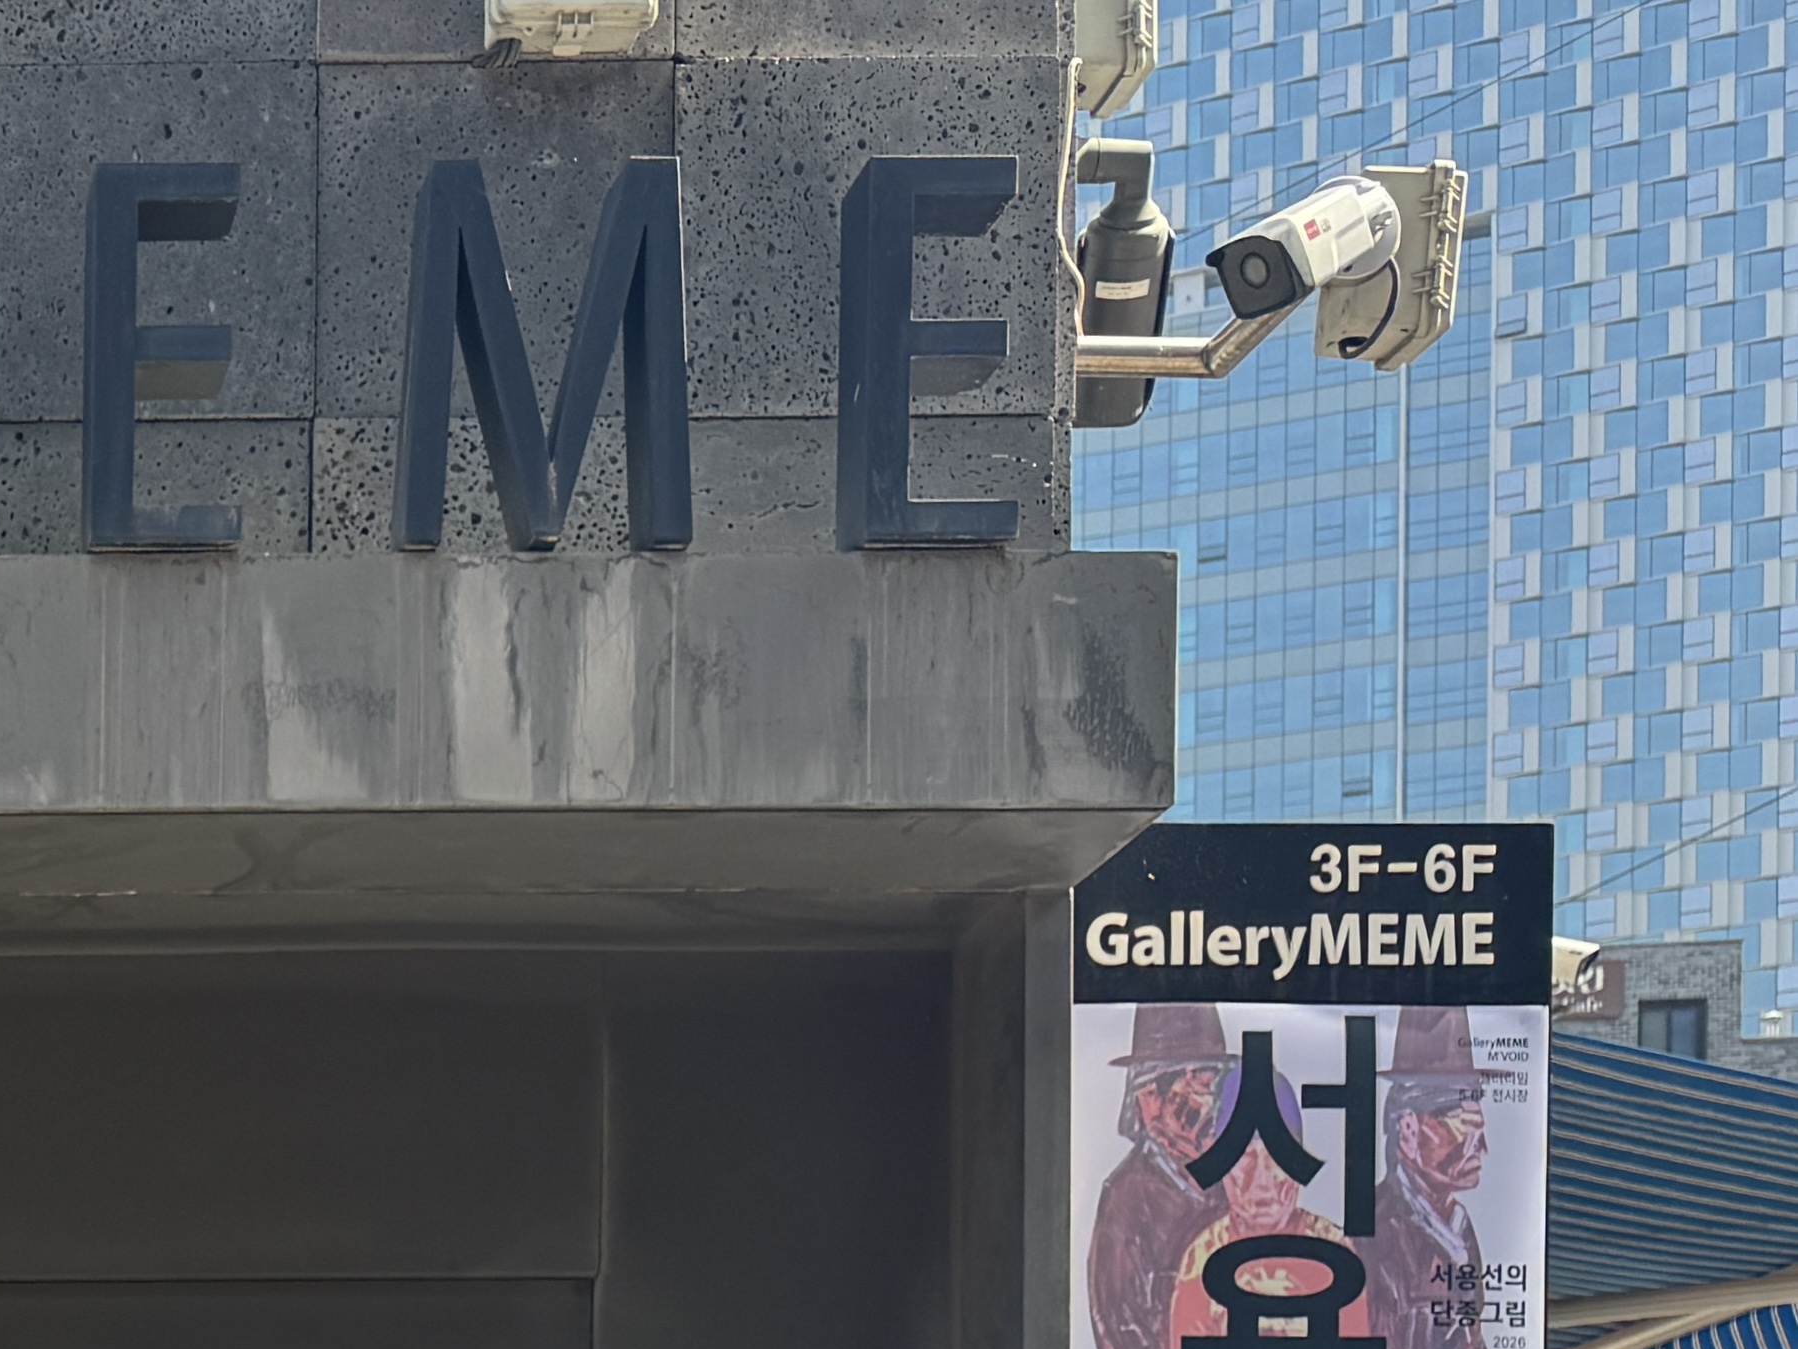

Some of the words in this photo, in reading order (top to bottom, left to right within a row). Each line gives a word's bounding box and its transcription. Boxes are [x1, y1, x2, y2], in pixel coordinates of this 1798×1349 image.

[1310, 843, 1497, 893] 3F-6F
[1085, 910, 1495, 981] GalleryMEME
[1431, 1264, 1527, 1293] 서용선의
[1493, 1337, 1526, 1349] 2026
